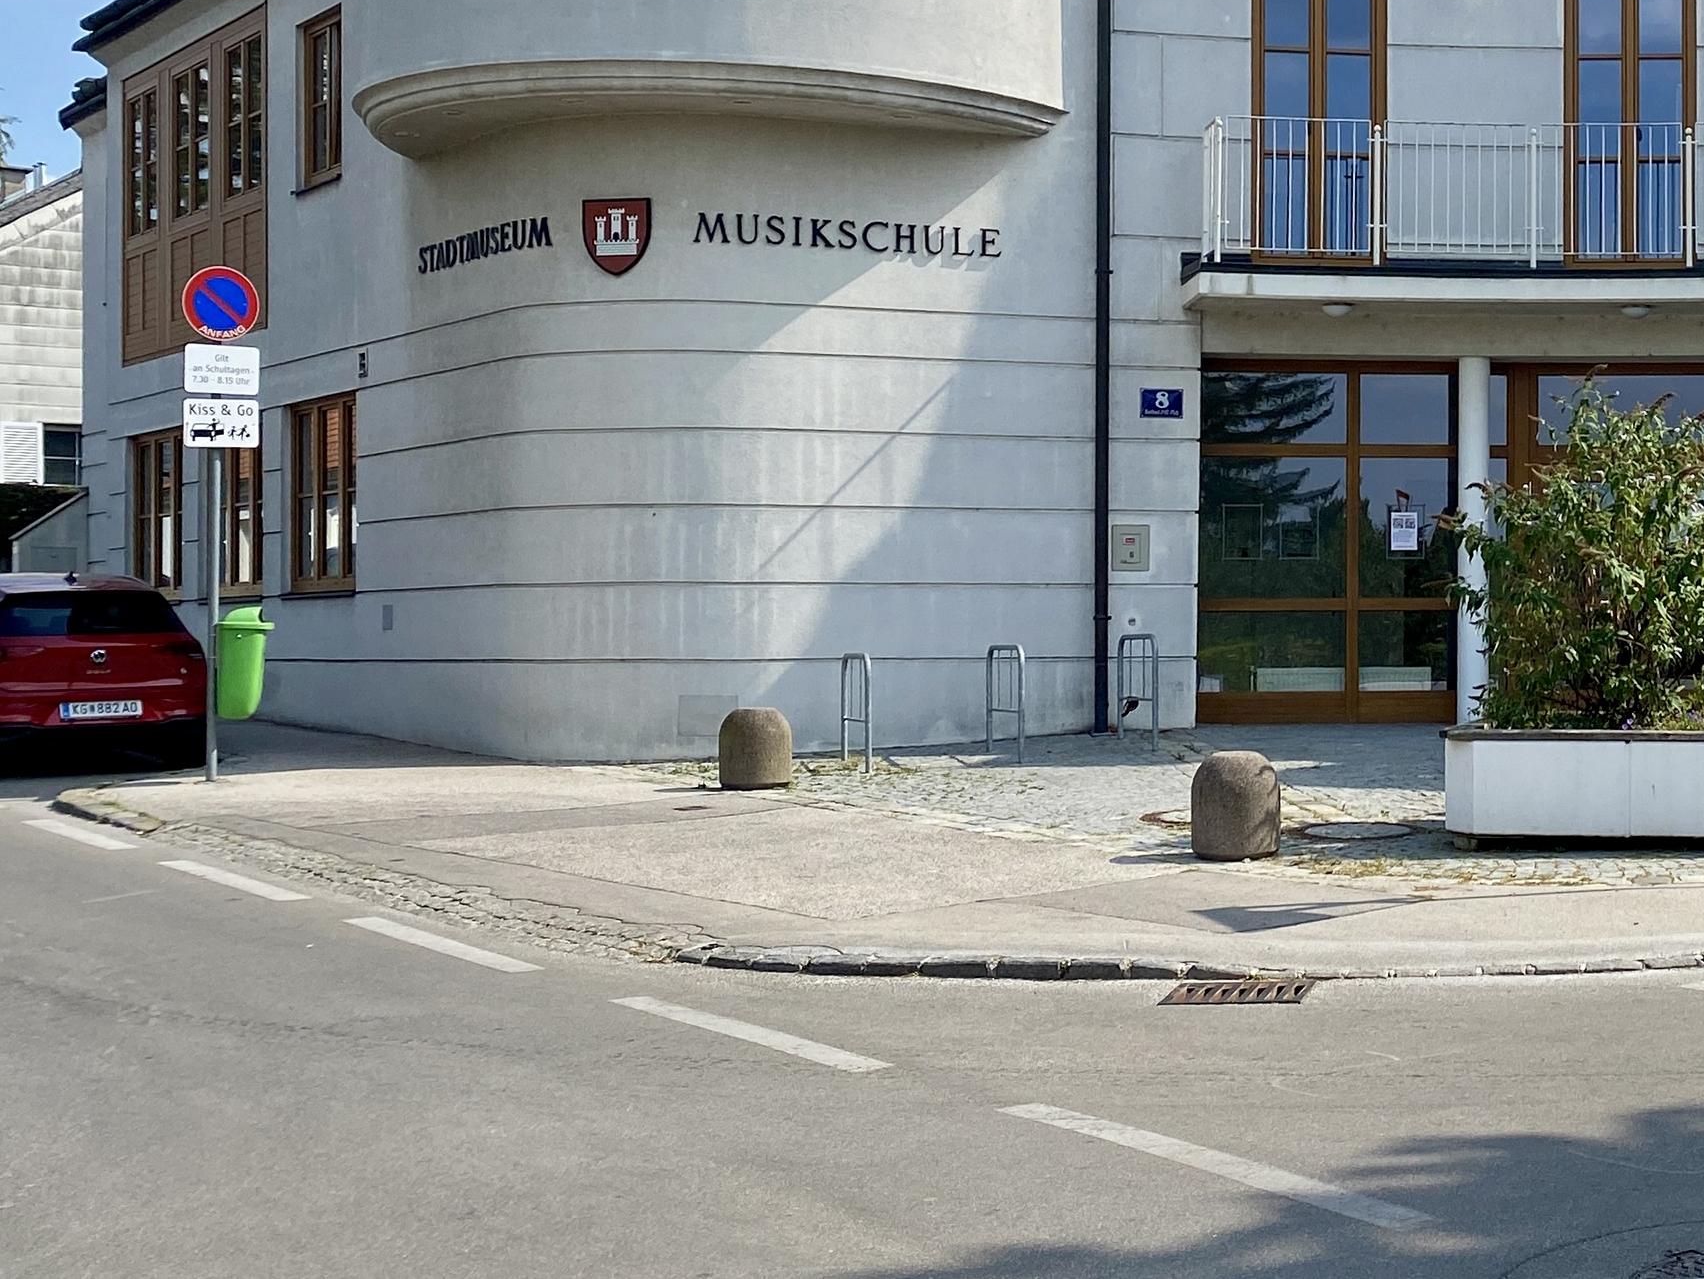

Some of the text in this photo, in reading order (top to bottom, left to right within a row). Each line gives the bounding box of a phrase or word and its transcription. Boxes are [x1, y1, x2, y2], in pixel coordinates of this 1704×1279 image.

[417, 212, 1002, 274] STADTMUSEUM MUSIKSCHULE
[199, 325, 247, 339] ANFANG
[214, 353, 230, 363] Gilt
[205, 365, 250, 375] Schultagen
[235, 376, 251, 386] Uhr
[1155, 391, 1170, 409] 8
[189, 403, 254, 417] Kiss & Go
[71, 704, 88, 715] KG
[97, 702, 120, 715] 882
